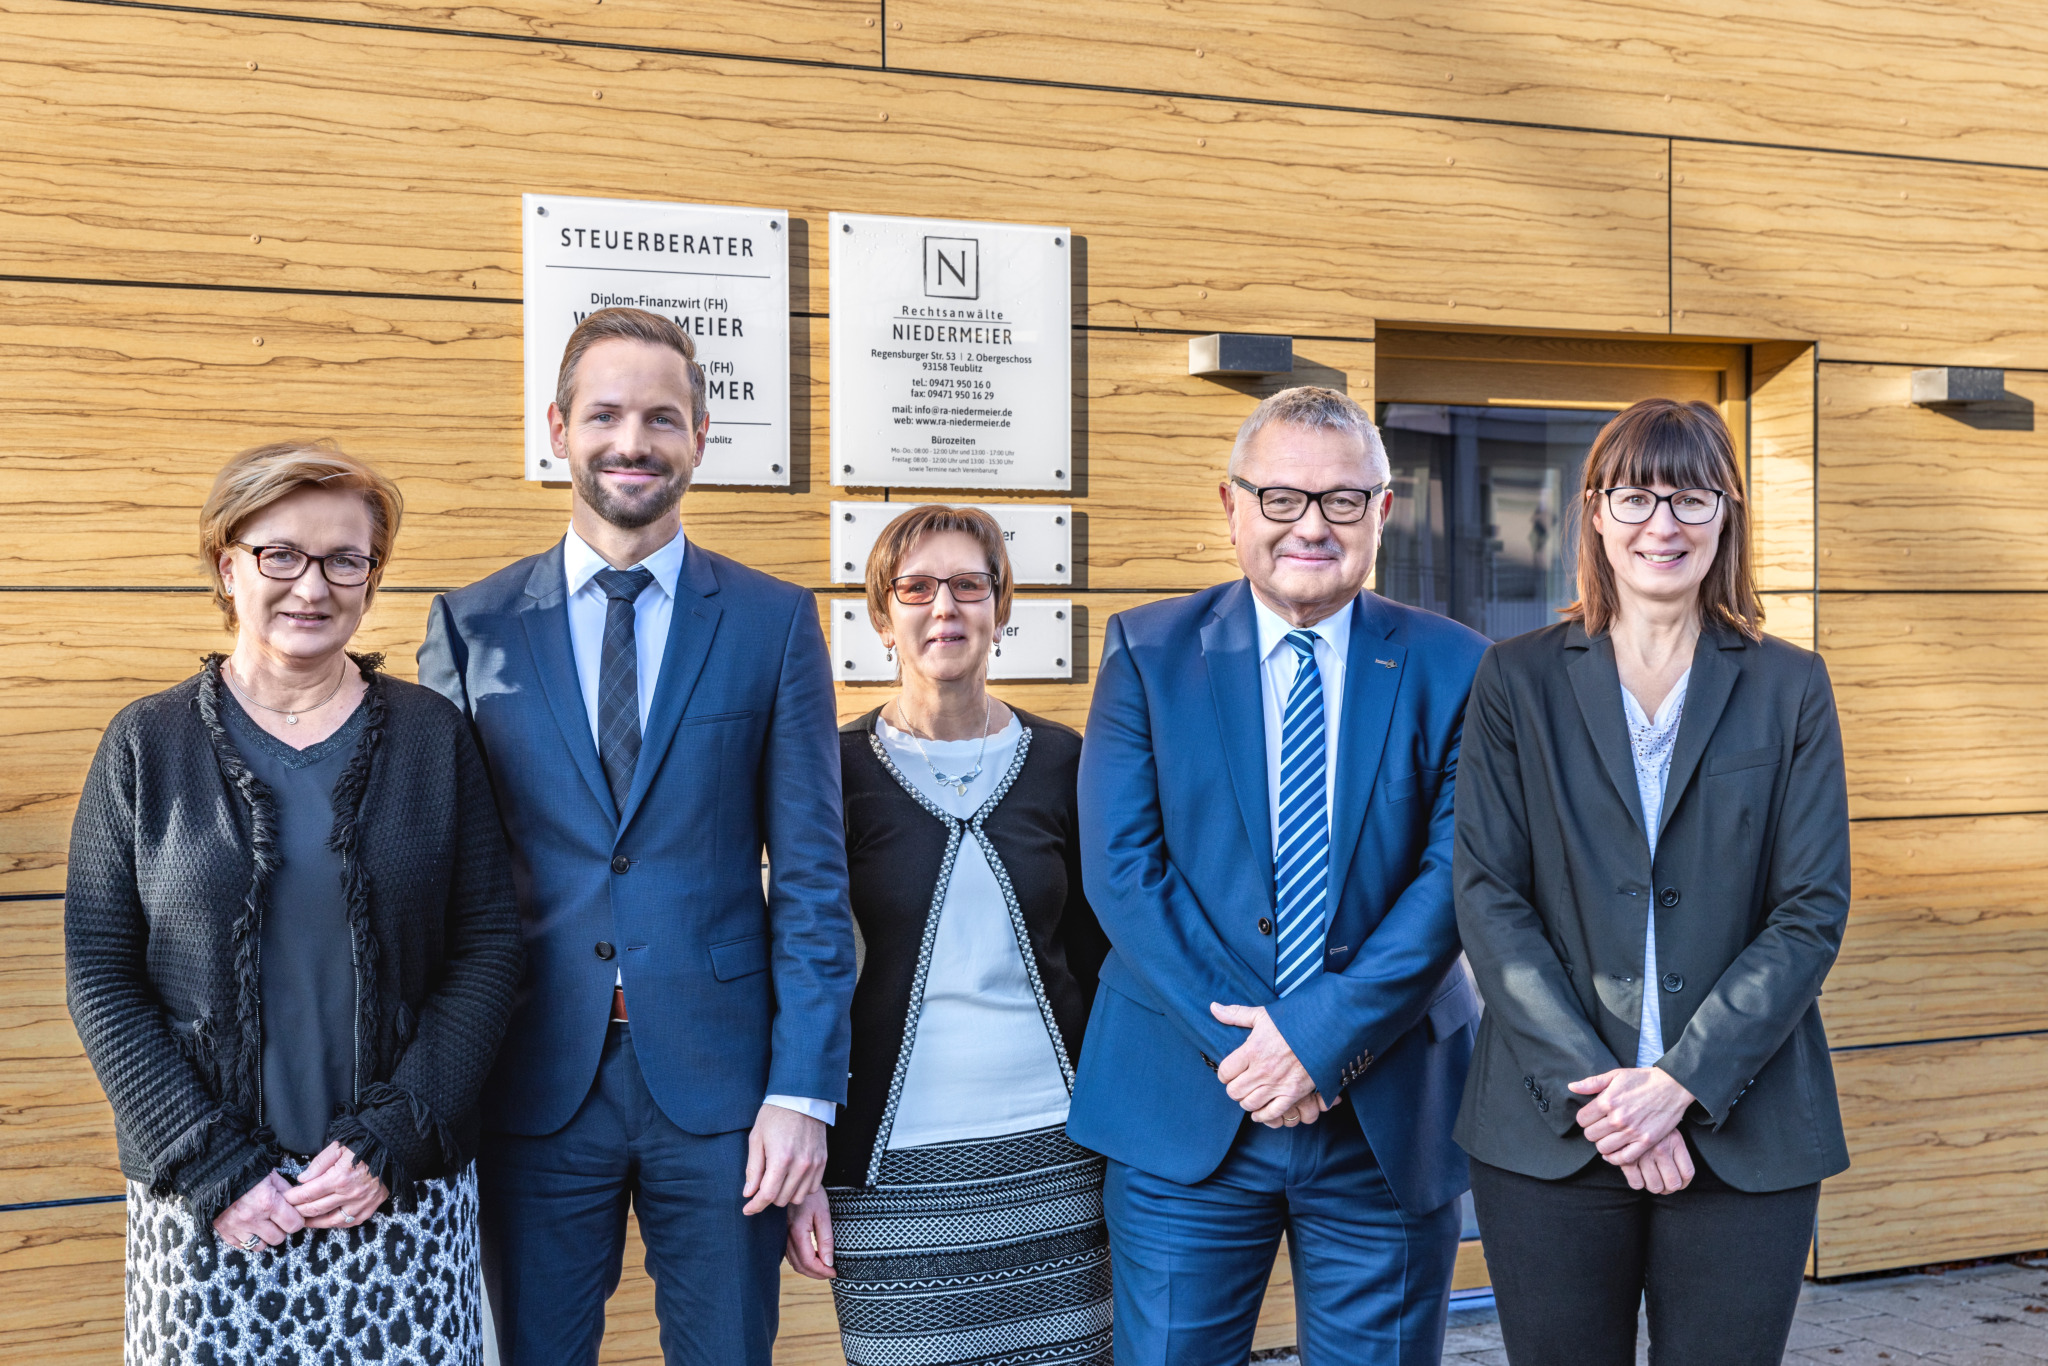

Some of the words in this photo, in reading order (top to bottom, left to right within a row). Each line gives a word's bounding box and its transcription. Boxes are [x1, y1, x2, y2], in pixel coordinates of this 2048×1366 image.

[560, 228, 754, 257] STEUERBERATER
[937, 249, 966, 287] N
[590, 293, 700, 309] Diplom-Finanzwirt
[704, 297, 728, 313] (FH)
[902, 306, 1004, 320] Rechtsanwälte
[892, 324, 1012, 344] NIEDERMEIER
[871, 349, 928, 362] Regensburger
[931, 352, 944, 360] Str.
[946, 352, 956, 360] 53
[967, 353, 974, 361] 2.
[976, 353, 1032, 364] Obergeschoss
[710, 361, 734, 376] (FH)
[922, 362, 948, 371] 93158
[950, 363, 983, 372] Teublitz
[929, 379, 954, 388] 09471
[956, 380, 972, 388] 950
[910, 389, 925, 398] fax:
[927, 390, 952, 398] 09471
[955, 390, 970, 399] 950
[972, 391, 982, 399] 16
[984, 392, 994, 400] 29
[892, 405, 912, 414] mail:
[914, 405, 1013, 417] info@ra-niedermeier.de
[894, 416, 914, 426] web:
[915, 417, 1011, 428] www.ra-niedermeier.de
[706, 436, 732, 444] eublitz
[931, 436, 976, 445] Bürozeiten
